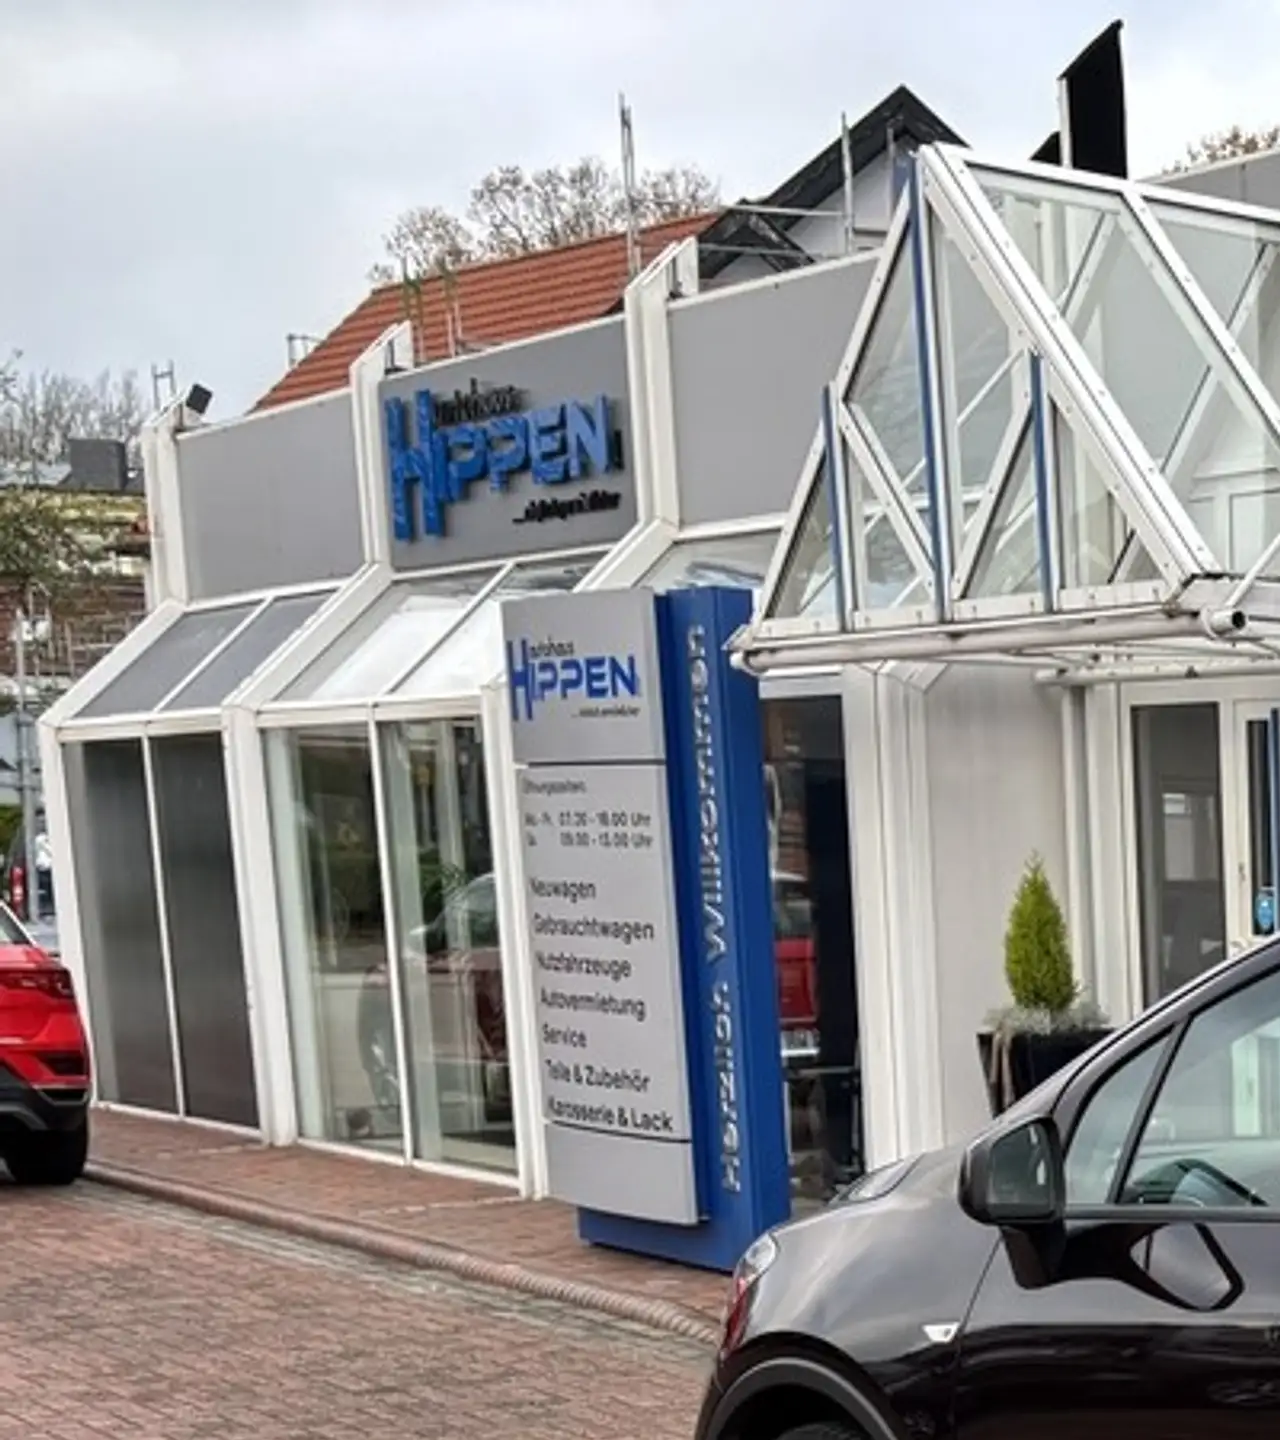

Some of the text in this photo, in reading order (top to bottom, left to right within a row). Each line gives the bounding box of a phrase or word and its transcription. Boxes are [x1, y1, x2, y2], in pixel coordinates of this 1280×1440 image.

[385, 389, 610, 541] HIPPEN
[506, 637, 638, 721] HIPPEN
[530, 877, 596, 903] Neuwagen
[687, 624, 742, 1193] Herzlich Willkommen
[533, 912, 654, 945] Gebrauchtwagen
[536, 951, 632, 982] Nutzfahrzeuge
[541, 987, 646, 1022] Autovermietung
[542, 1023, 588, 1049] Service
[545, 1059, 651, 1092] Teile & Zubehör
[548, 1096, 674, 1132] Karosserie & Lack
